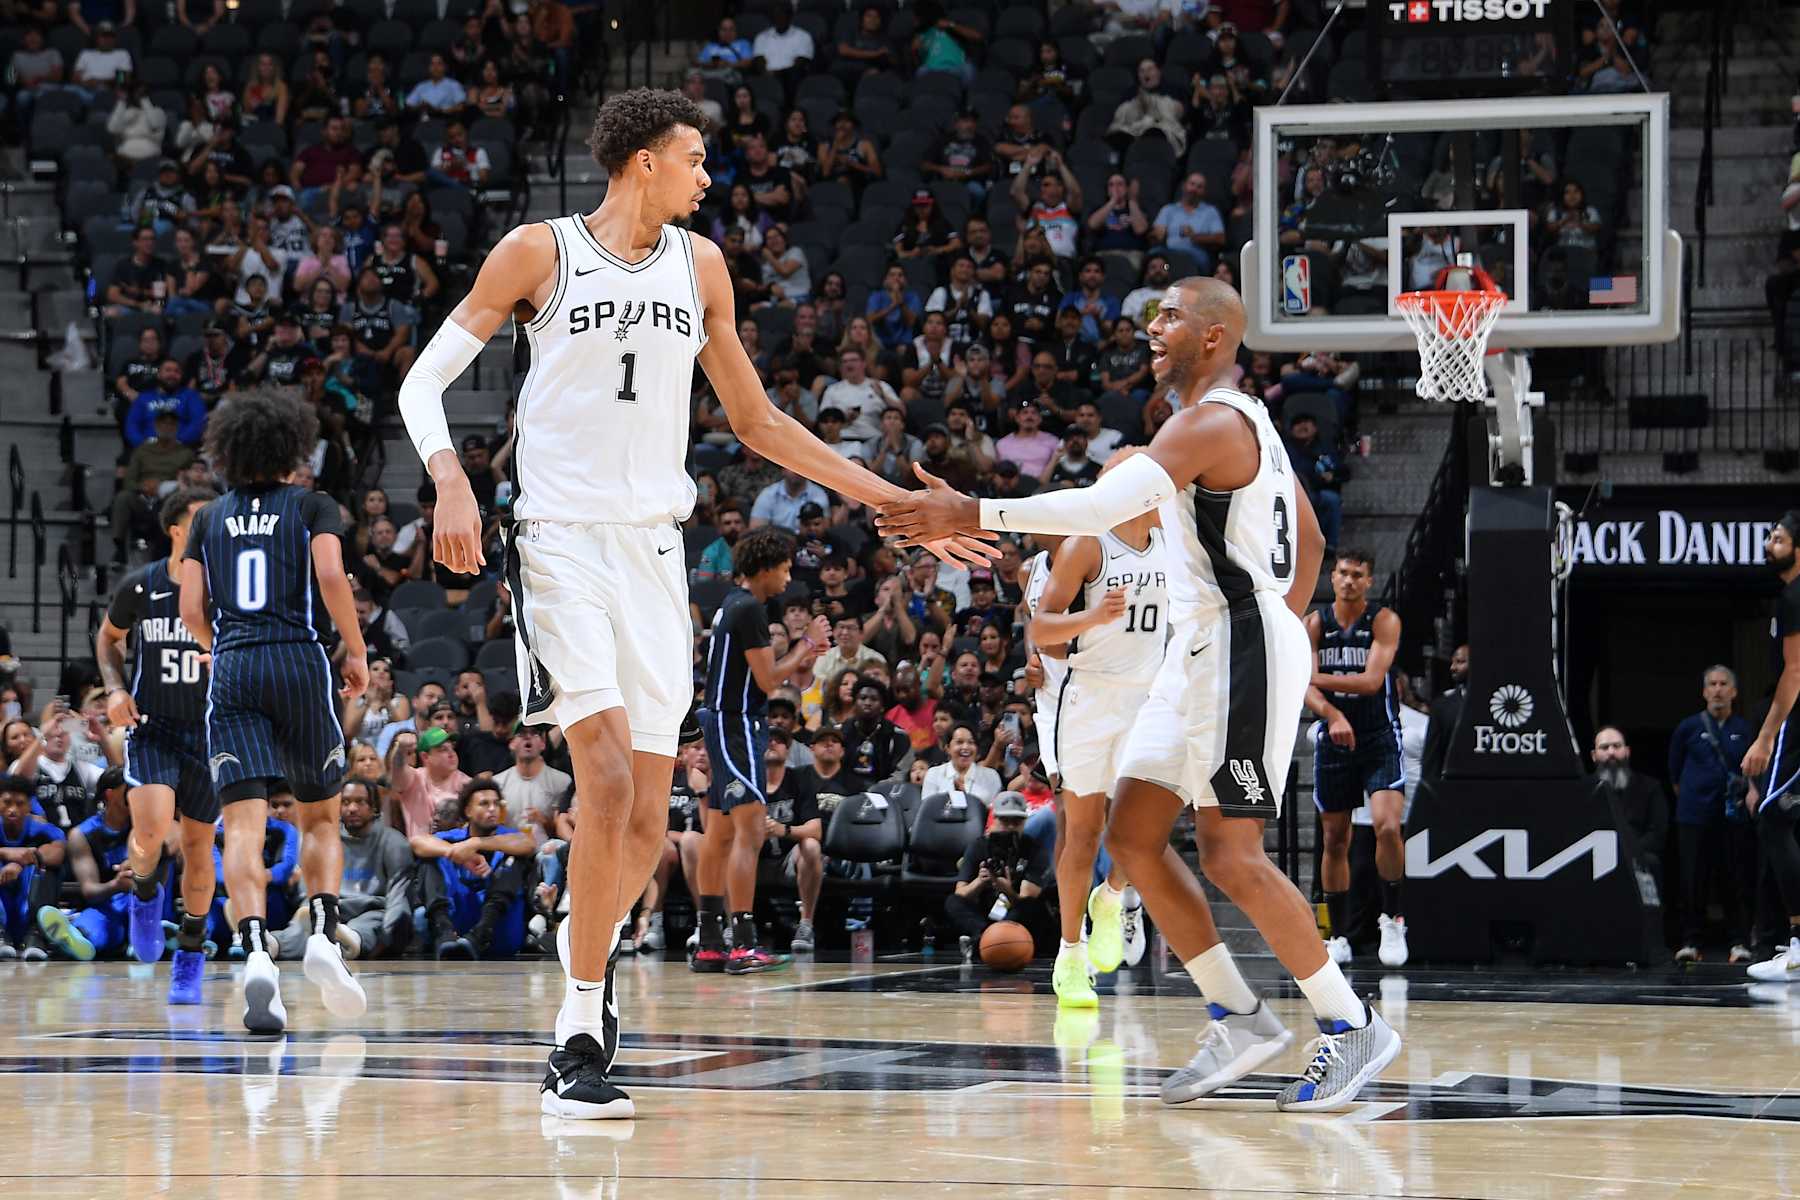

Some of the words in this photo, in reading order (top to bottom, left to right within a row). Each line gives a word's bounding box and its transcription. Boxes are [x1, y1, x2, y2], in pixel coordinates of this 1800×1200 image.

[1432, 0, 1550, 21] TISSOT
[569, 300, 691, 343] SPURS
[616, 350, 638, 403] 1
[225, 513, 280, 538] BLACK
[1270, 492, 1293, 581] 3
[237, 548, 267, 611] 0
[1125, 603, 1158, 633] 10
[161, 648, 200, 684] 50
[1319, 646, 1370, 667] ORLAND
[1473, 725, 1547, 754] Frost
[1405, 828, 1618, 881] KIA
